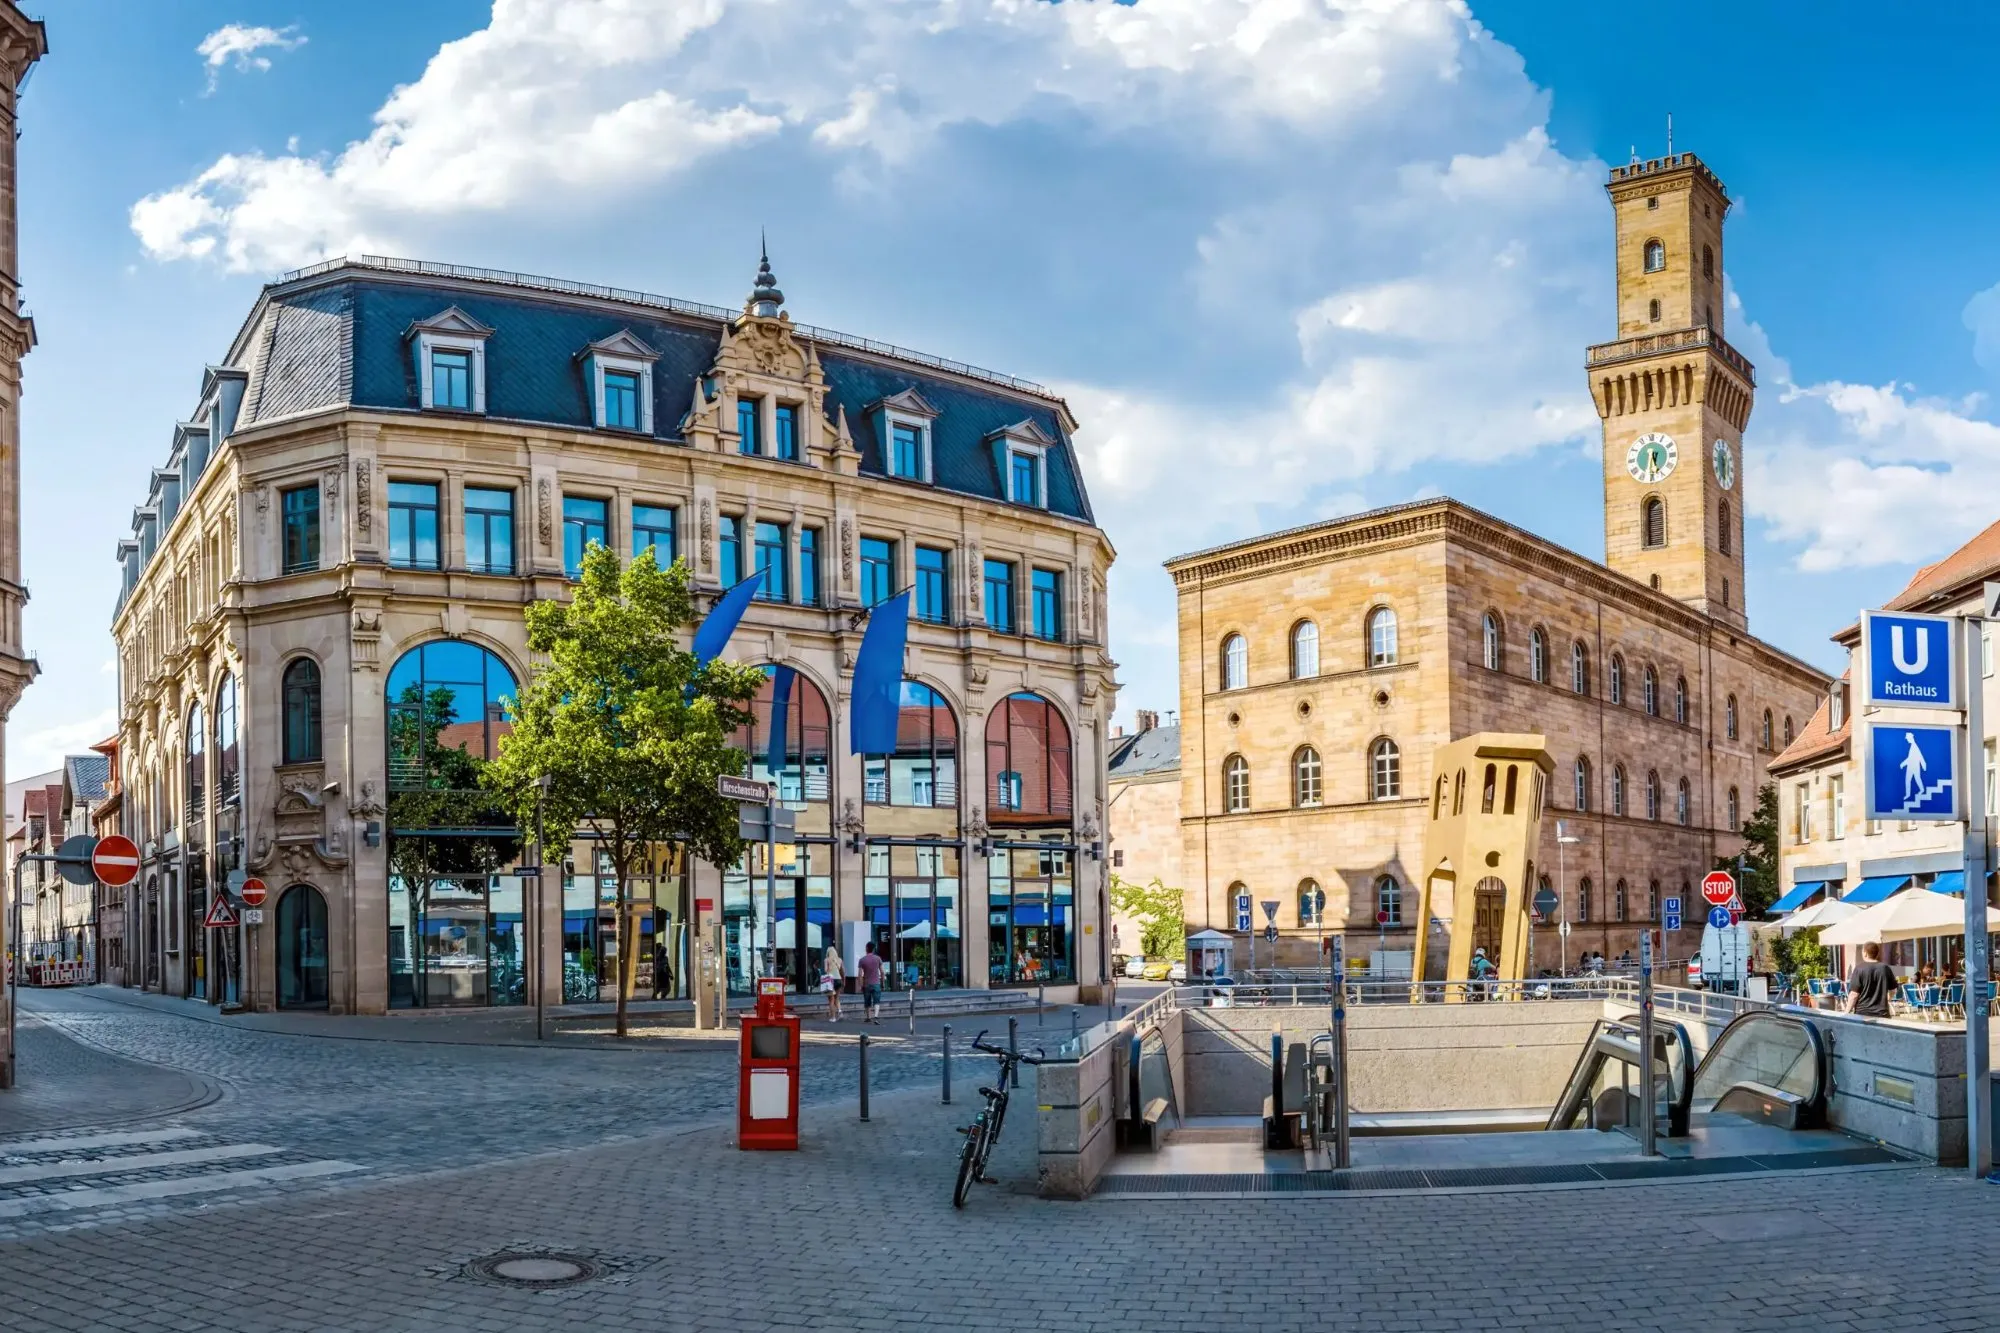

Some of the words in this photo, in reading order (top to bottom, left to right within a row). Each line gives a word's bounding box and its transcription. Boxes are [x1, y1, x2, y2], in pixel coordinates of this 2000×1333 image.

[1891, 625, 1929, 675] U
[1885, 681, 1938, 697] Rathaus
[722, 780, 766, 798] Hirschenstraße
[1705, 881, 1732, 895] STOP
[1669, 900, 1676, 908] U
